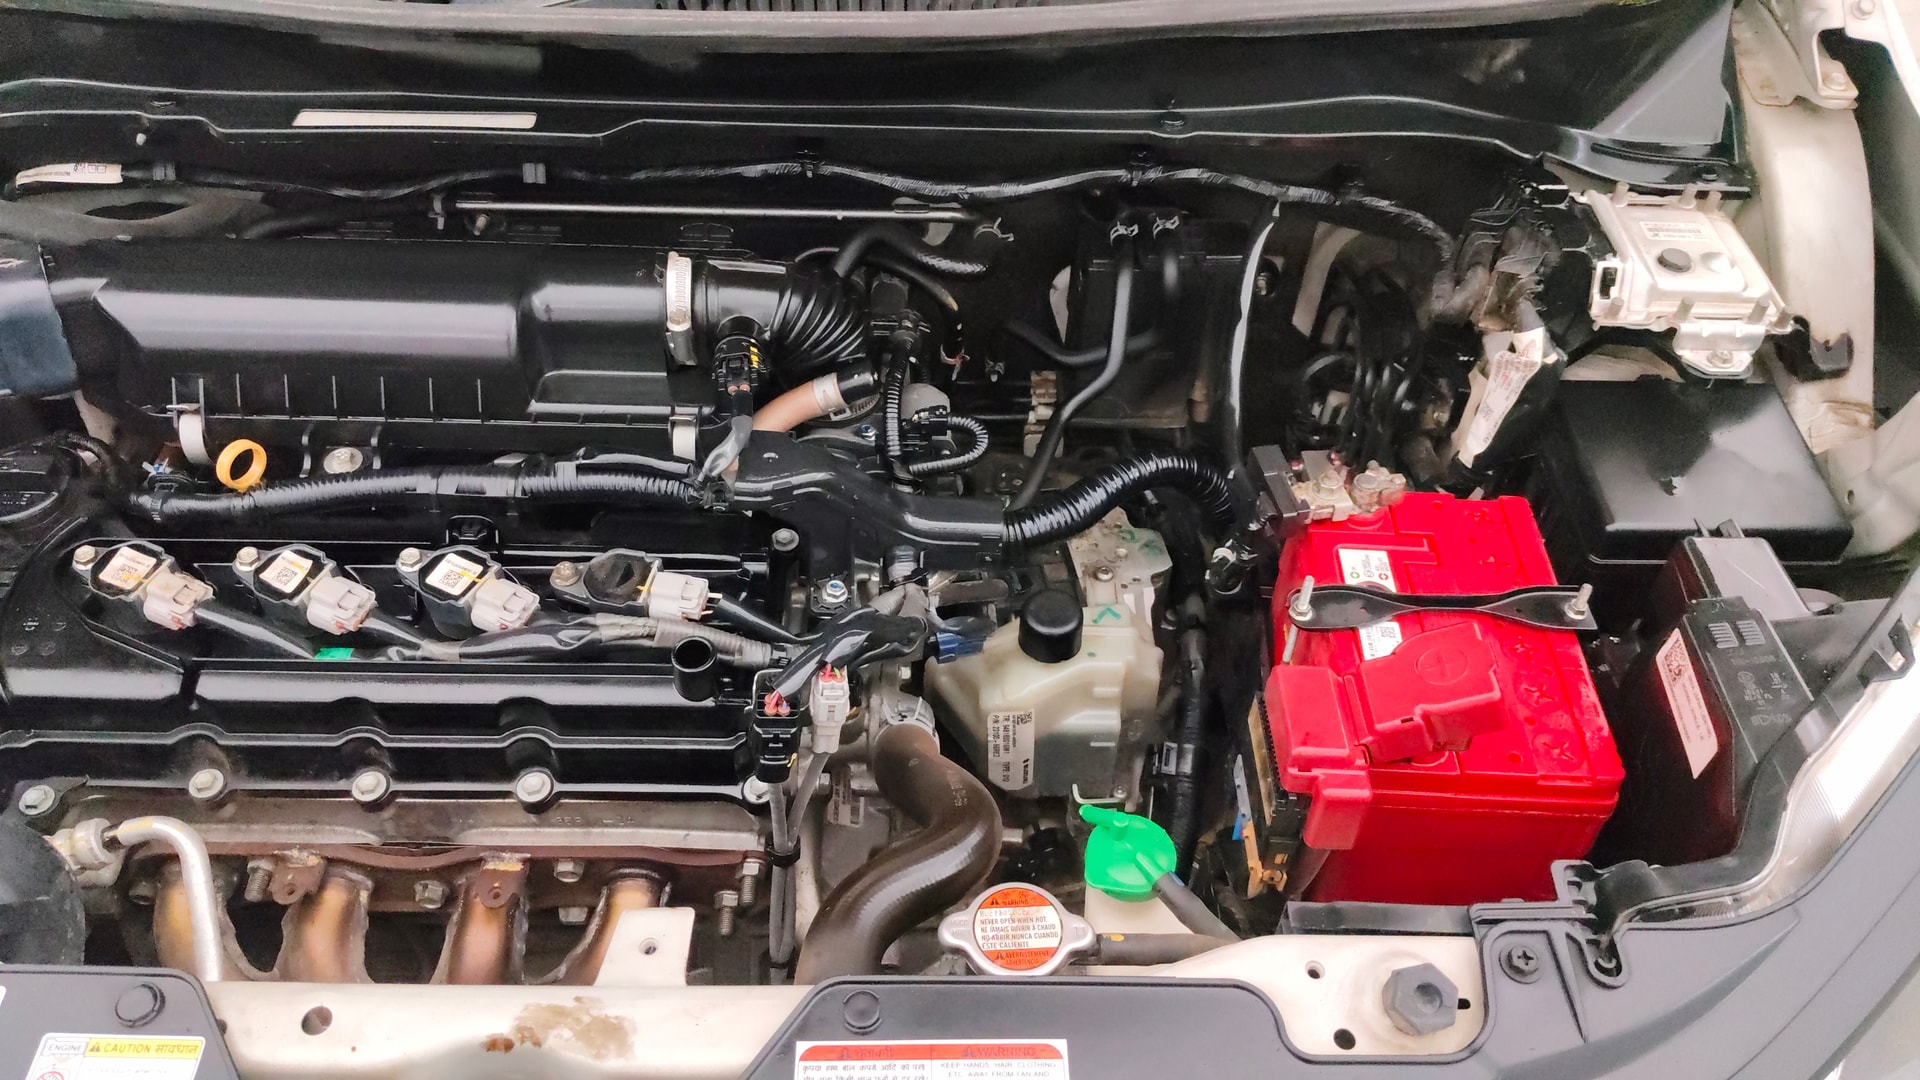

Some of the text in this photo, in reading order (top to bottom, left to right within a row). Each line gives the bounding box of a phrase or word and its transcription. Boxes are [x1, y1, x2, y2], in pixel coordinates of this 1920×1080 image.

[980, 918, 999, 926] NEVER
[980, 926, 988, 934] NE
[1034, 932, 1059, 940] CUANDO
[48, 1044, 83, 1053] ENGINE
[103, 1043, 150, 1054] CAUTION
[155, 1044, 200, 1055] सावधान
[977, 1046, 1036, 1057] WARNING
[802, 1063, 822, 1075] कृपया
